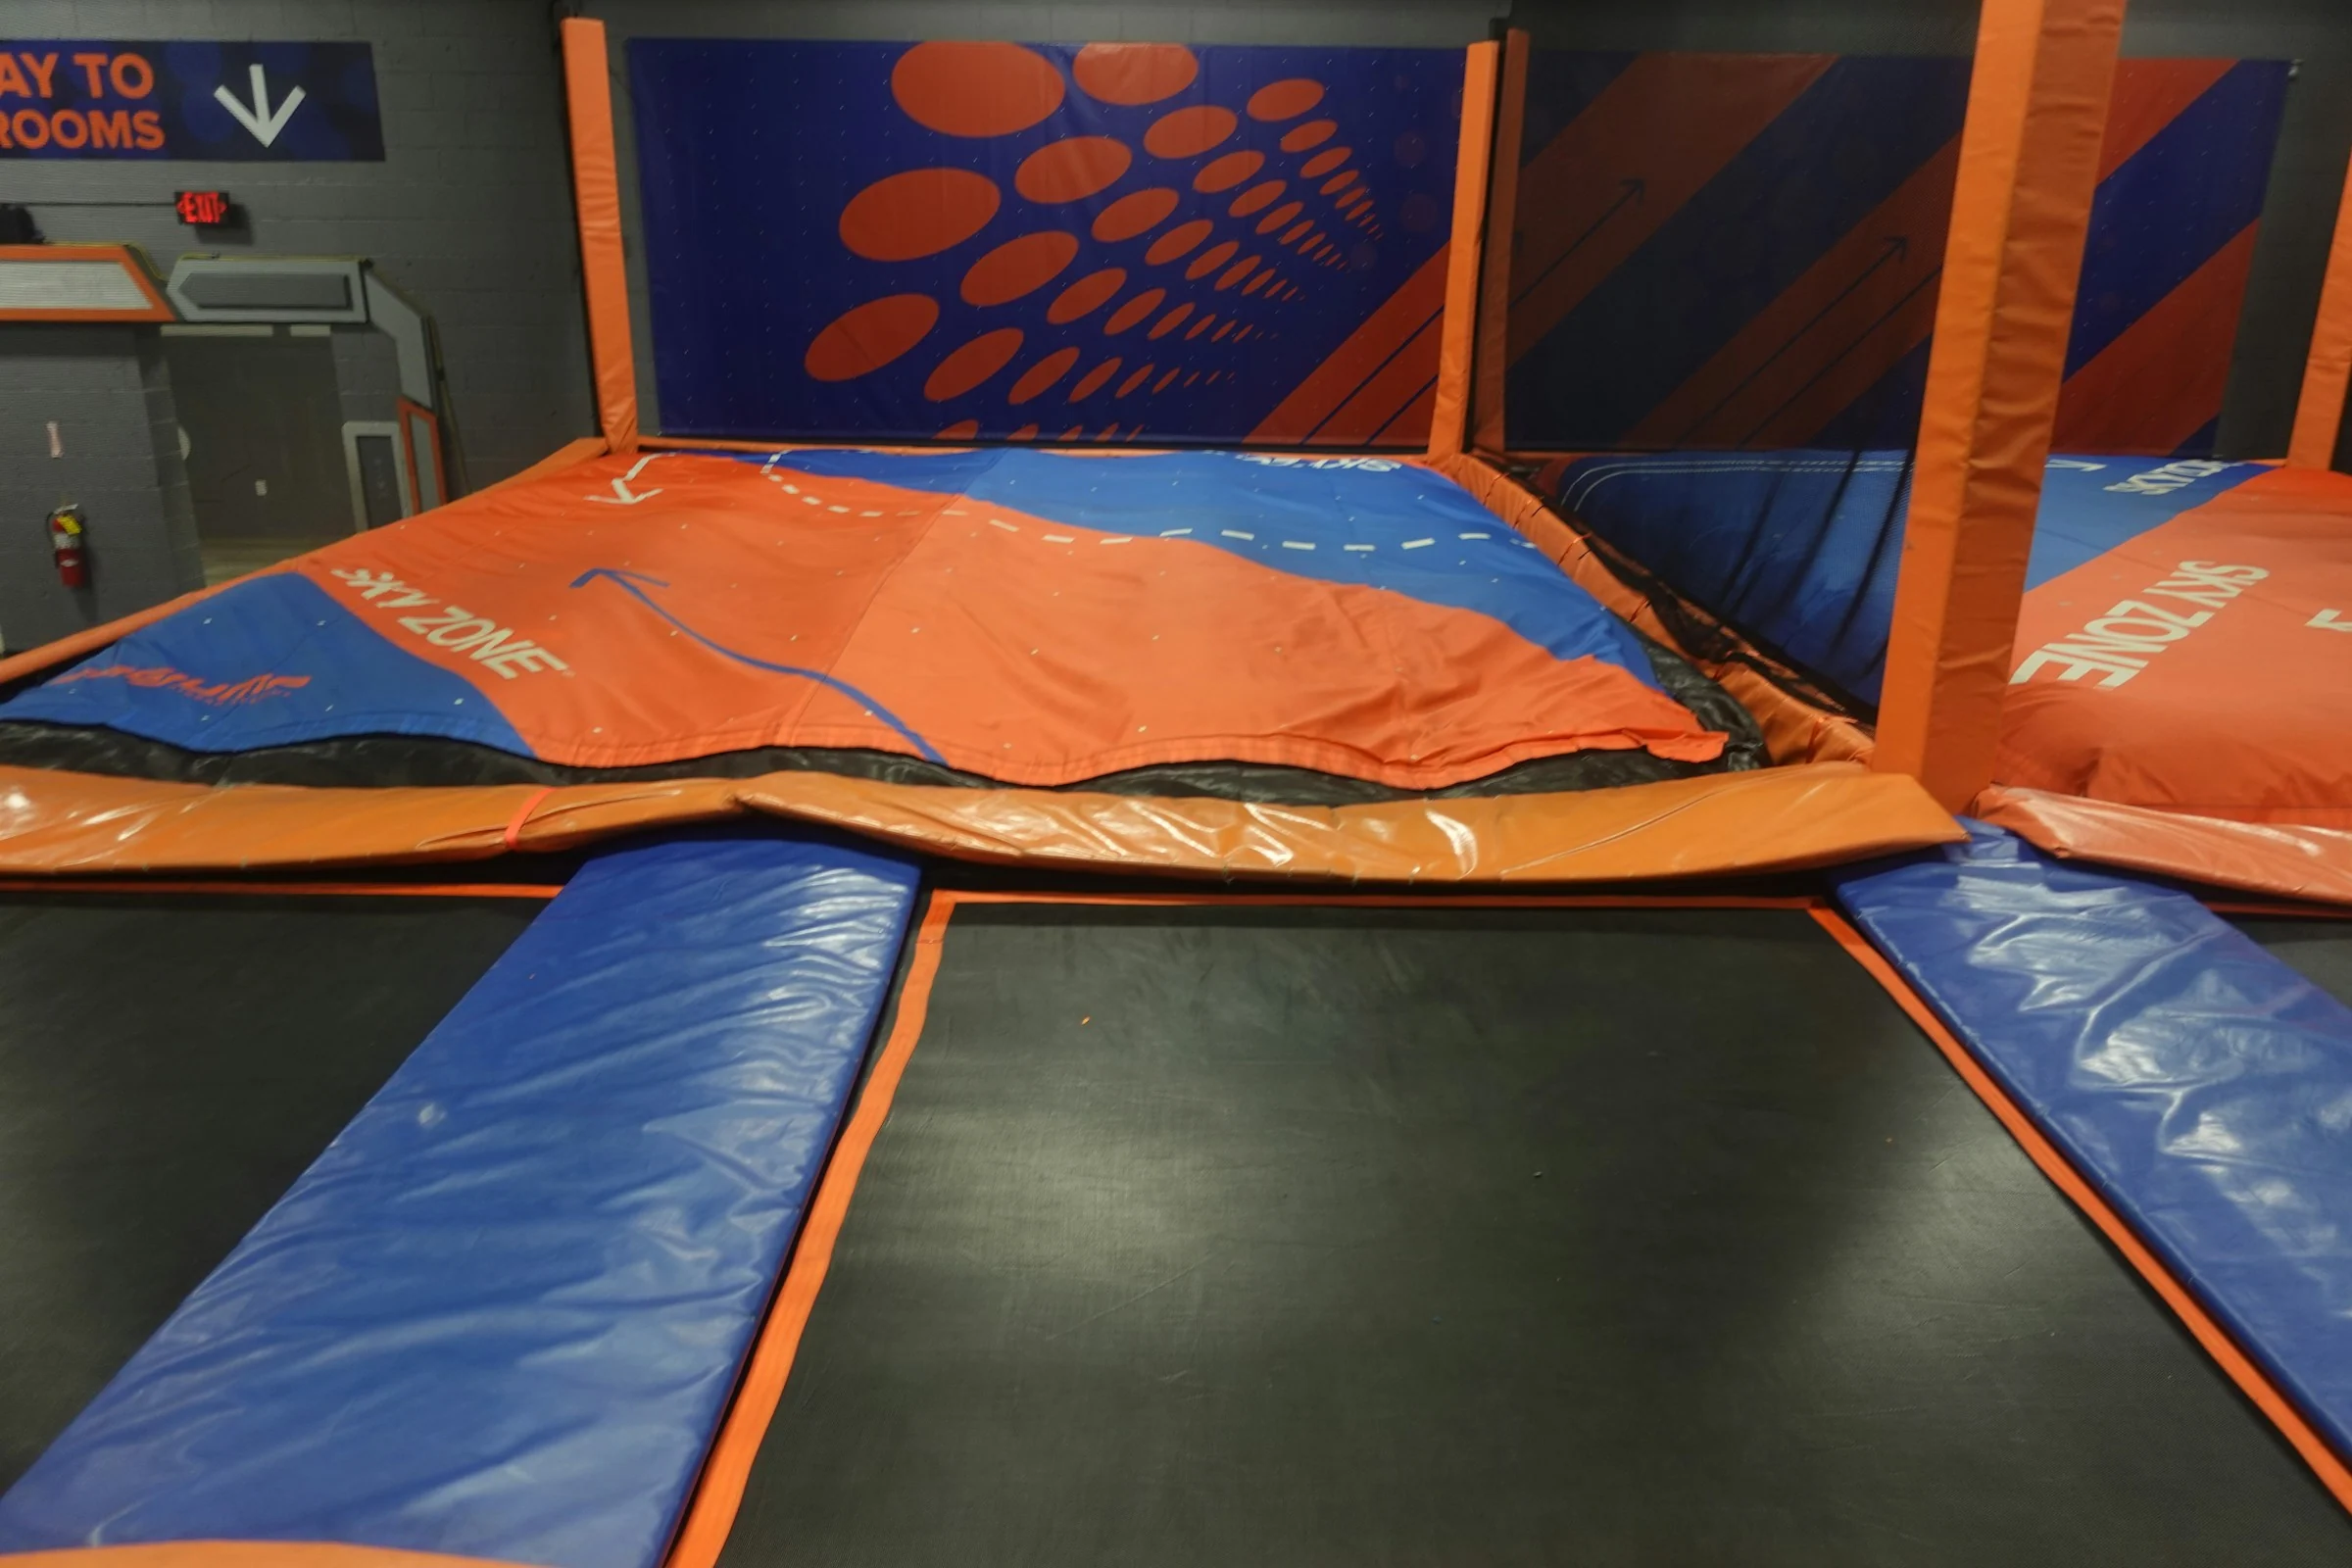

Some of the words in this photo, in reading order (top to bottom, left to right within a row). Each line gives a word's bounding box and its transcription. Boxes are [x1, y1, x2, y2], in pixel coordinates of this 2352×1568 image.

[0, 52, 59, 99] AY
[73, 52, 155, 100] TO
[182, 190, 220, 223] EXIT
[2141, 561, 2270, 609] SKY
[330, 568, 440, 609] SKY
[397, 606, 569, 680] ZONE
[2008, 600, 2216, 692] ZONE
